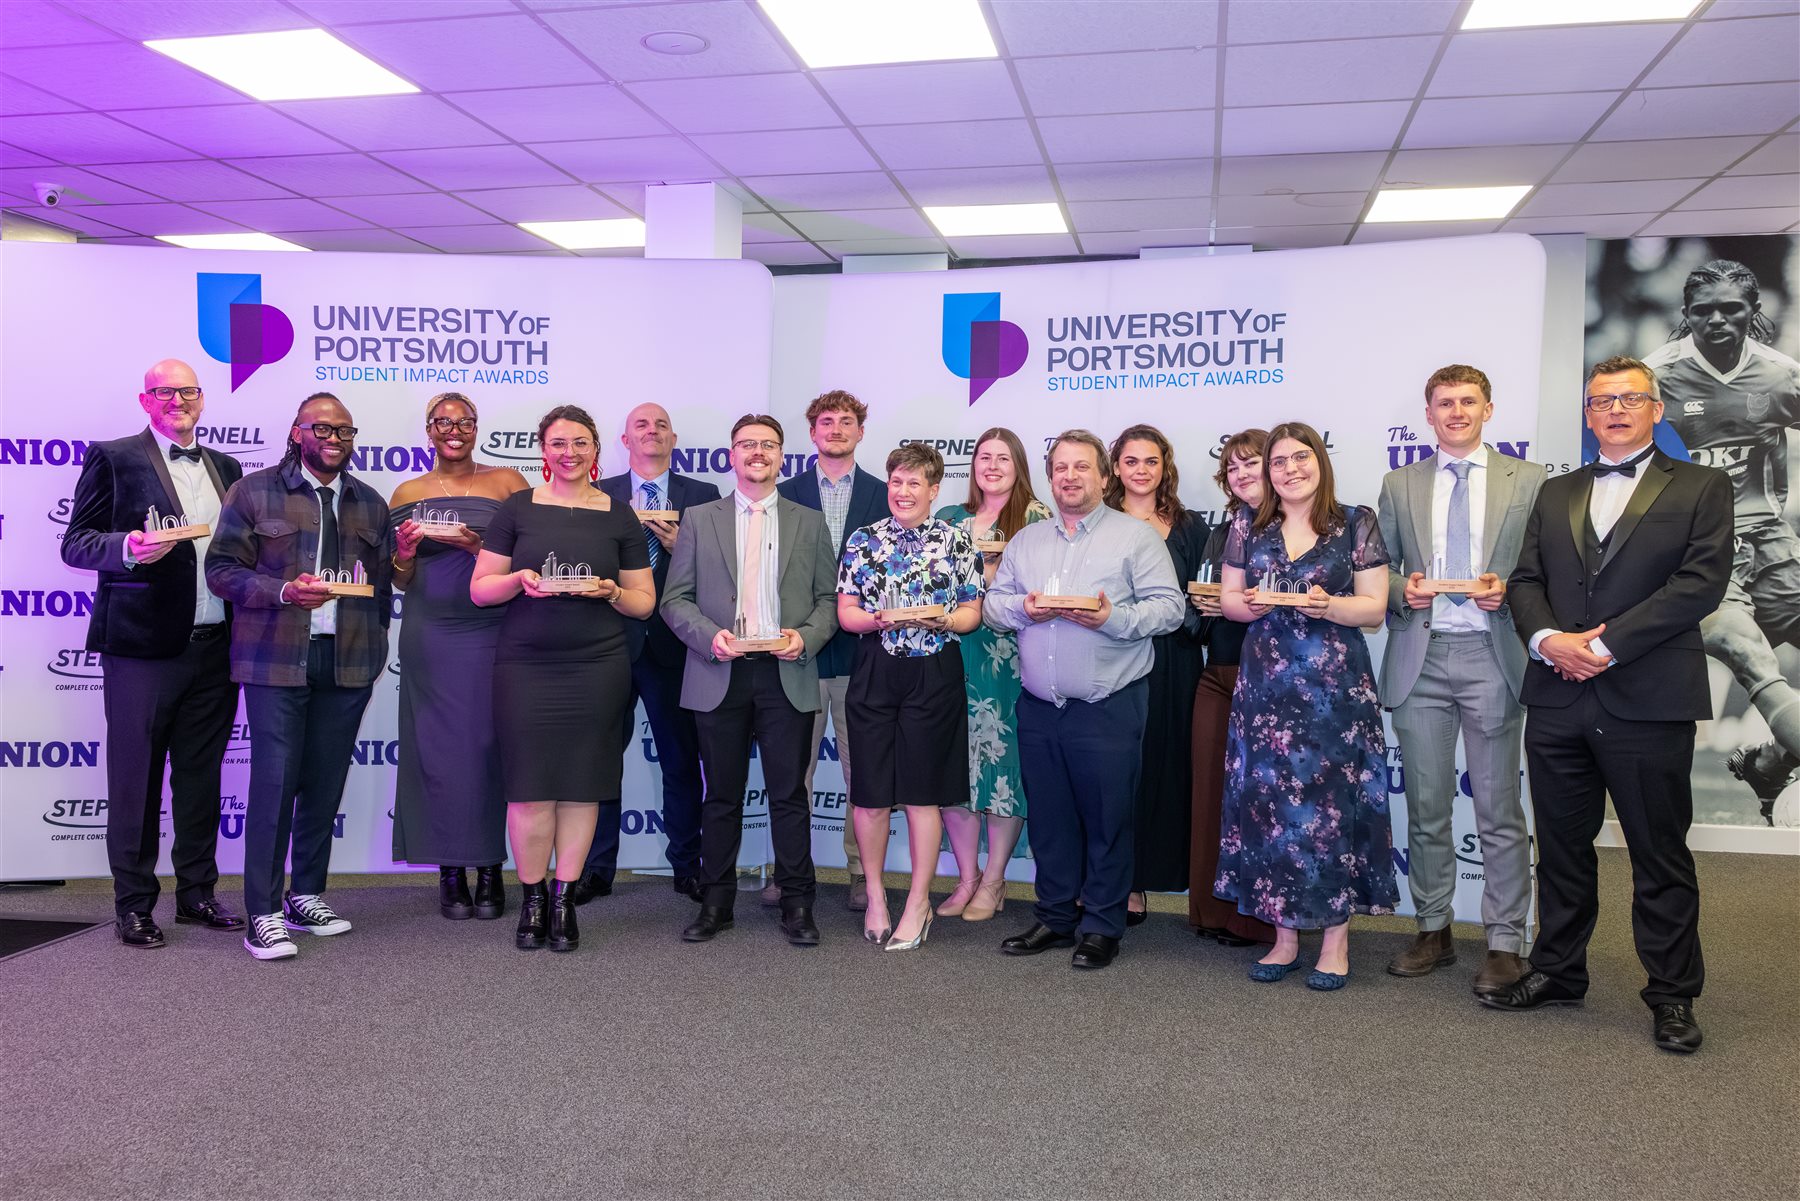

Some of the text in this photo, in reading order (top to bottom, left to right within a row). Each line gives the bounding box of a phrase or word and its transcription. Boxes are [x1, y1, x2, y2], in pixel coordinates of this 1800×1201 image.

[313, 305, 550, 335] UNIVERSITY OF
[1047, 308, 1287, 342] UNIVERSITY OF
[314, 336, 548, 366] PORTSMOUTH
[1047, 338, 1284, 372] PORTSMOUTH
[315, 366, 549, 385] STUDENT IMPACT AWARDS
[1047, 369, 1284, 391] STUDENT IMPACT AWARDS
[195, 426, 265, 445] PNELL
[488, 431, 540, 449] STEP
[1387, 425, 1418, 442] The
[0, 438, 94, 466] NION
[241, 461, 265, 469] ARTNER
[346, 445, 436, 472] NION
[671, 447, 733, 474] NIO
[0, 590, 97, 617] NION
[0, 741, 100, 768] NION
[51, 799, 109, 818] STEP
[811, 823, 827, 831] PLETE
